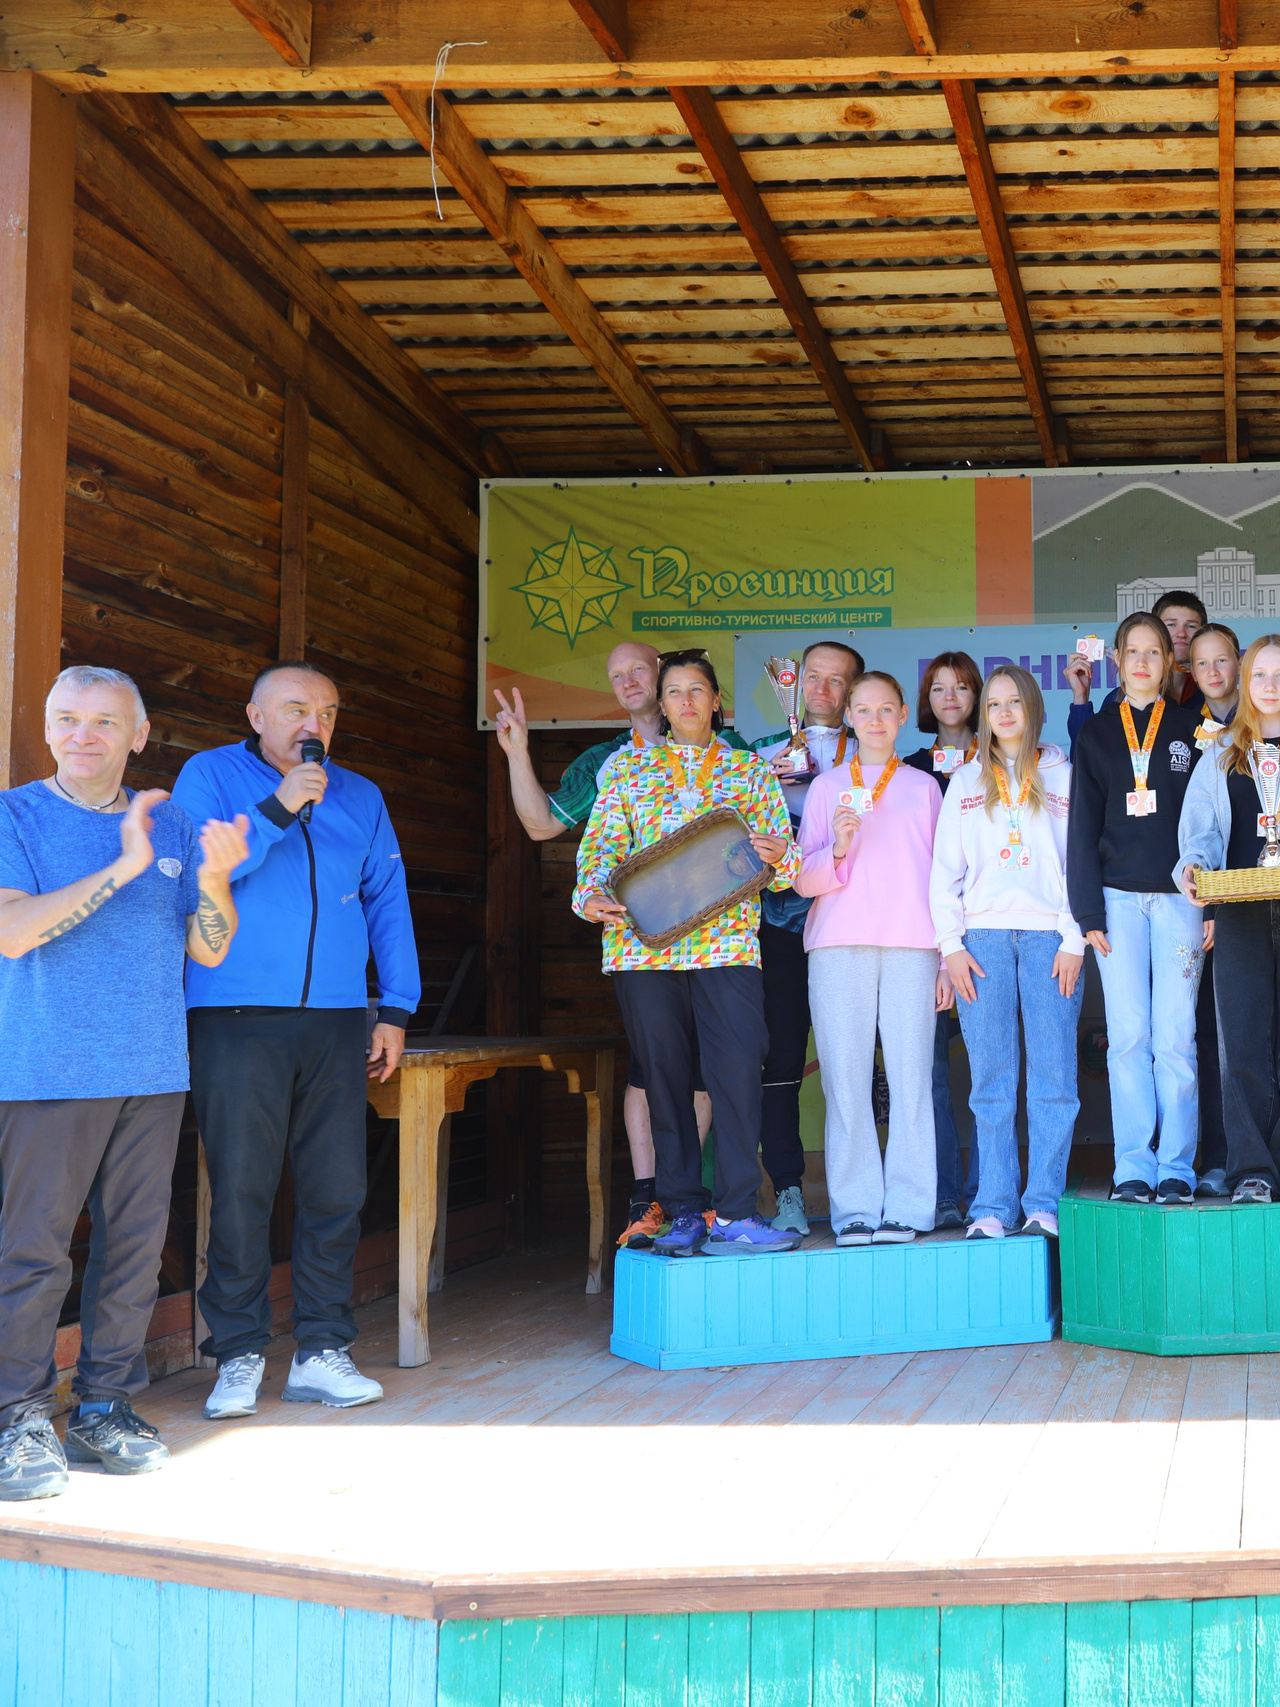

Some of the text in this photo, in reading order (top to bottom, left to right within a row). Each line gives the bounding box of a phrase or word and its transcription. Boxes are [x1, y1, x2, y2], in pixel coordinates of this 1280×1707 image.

[628, 545, 894, 608] Провинция
[641, 611, 883, 627] СПОРТИВНО-ТУРИСТИЧЕСКИЙ ЦЕНТР
[864, 800, 872, 809] 2
[1149, 801, 1154, 809] 1
[1021, 856, 1029, 865] 2
